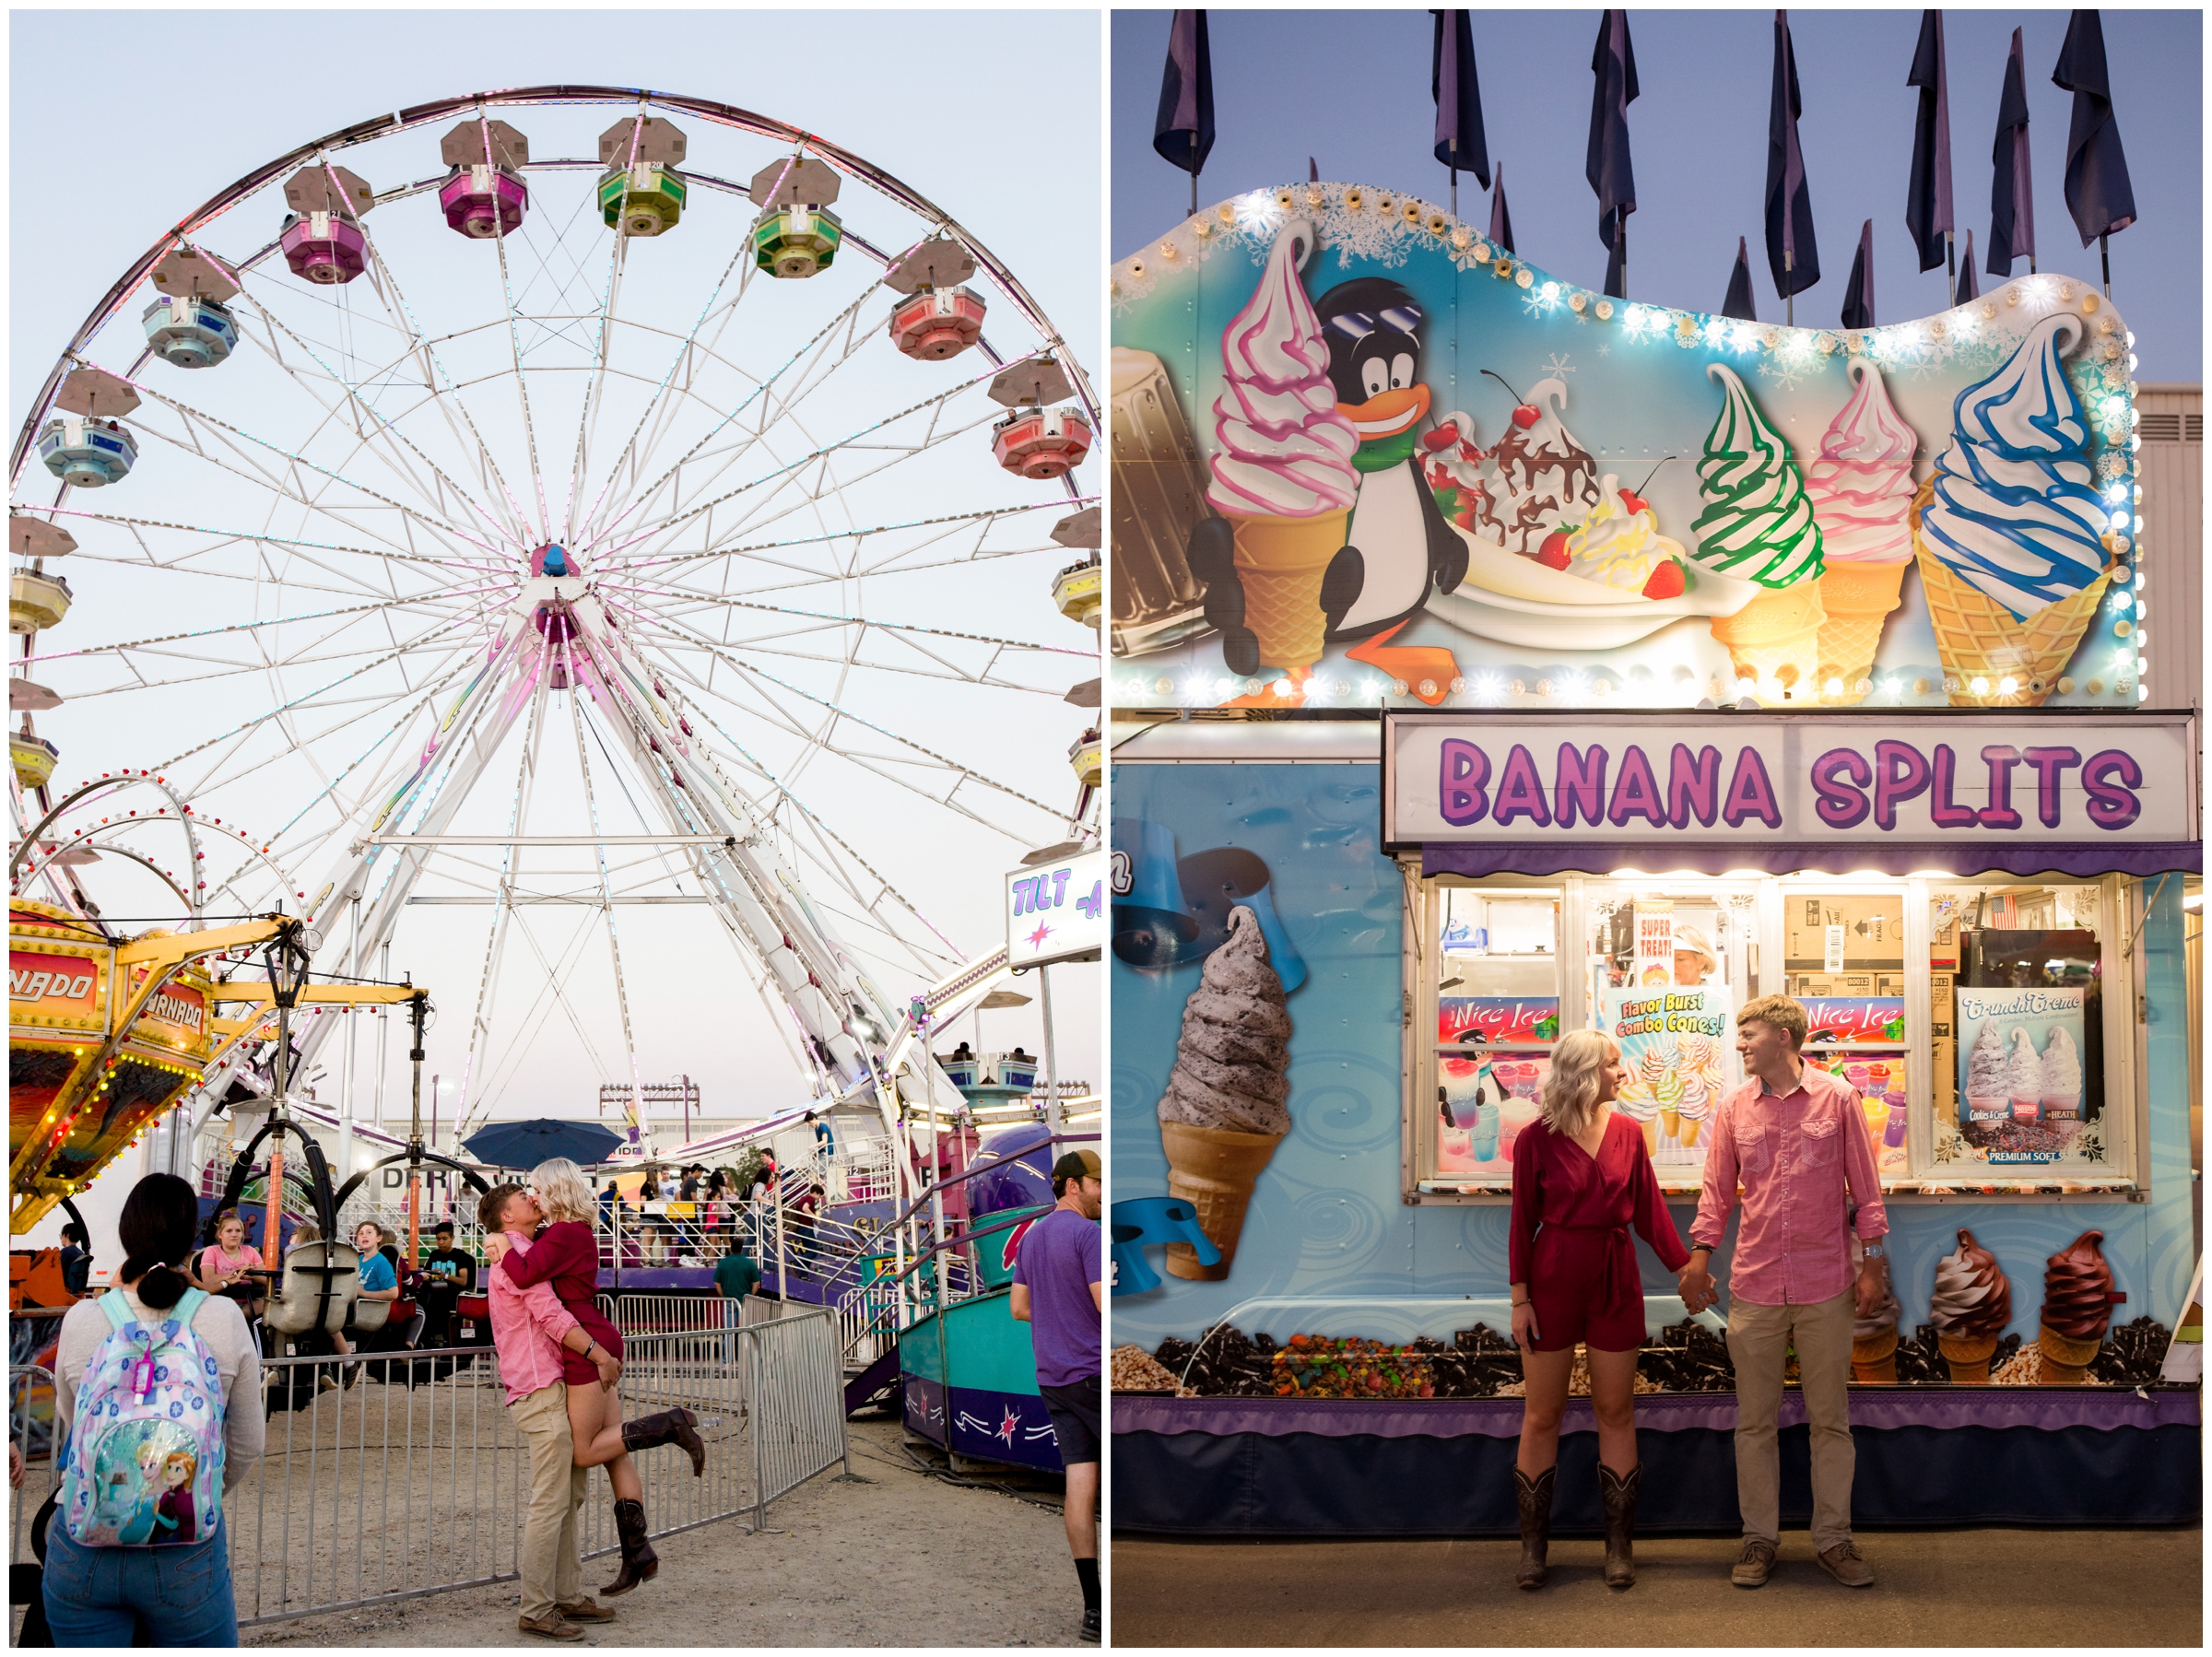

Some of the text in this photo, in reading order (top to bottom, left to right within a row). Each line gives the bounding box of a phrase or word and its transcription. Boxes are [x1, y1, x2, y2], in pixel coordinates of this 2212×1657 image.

[84, 417, 89, 425] 4
[1440, 738, 2143, 831] BANANA SPLITS
[1013, 868, 1071, 916] TILT
[1641, 919, 1671, 937] SUPER
[1640, 939, 1672, 958] TREAT!
[1848, 978, 1869, 986] 80012
[1453, 1001, 1548, 1029] Nice Ice
[1621, 992, 1705, 1020] Flavor Burst
[1807, 1002, 1899, 1029] Nice Ice
[1616, 1013, 1726, 1038] Combo Cones!
[999, 1052, 1010, 1061] 13
[1970, 1110, 2009, 1122] Cookies & Creme
[2051, 1111, 2076, 1120] HEATH
[1989, 1152, 2031, 1161] PREMIUM
[2033, 1152, 2056, 1161] SOFT
[848, 1167, 859, 1176] 12
